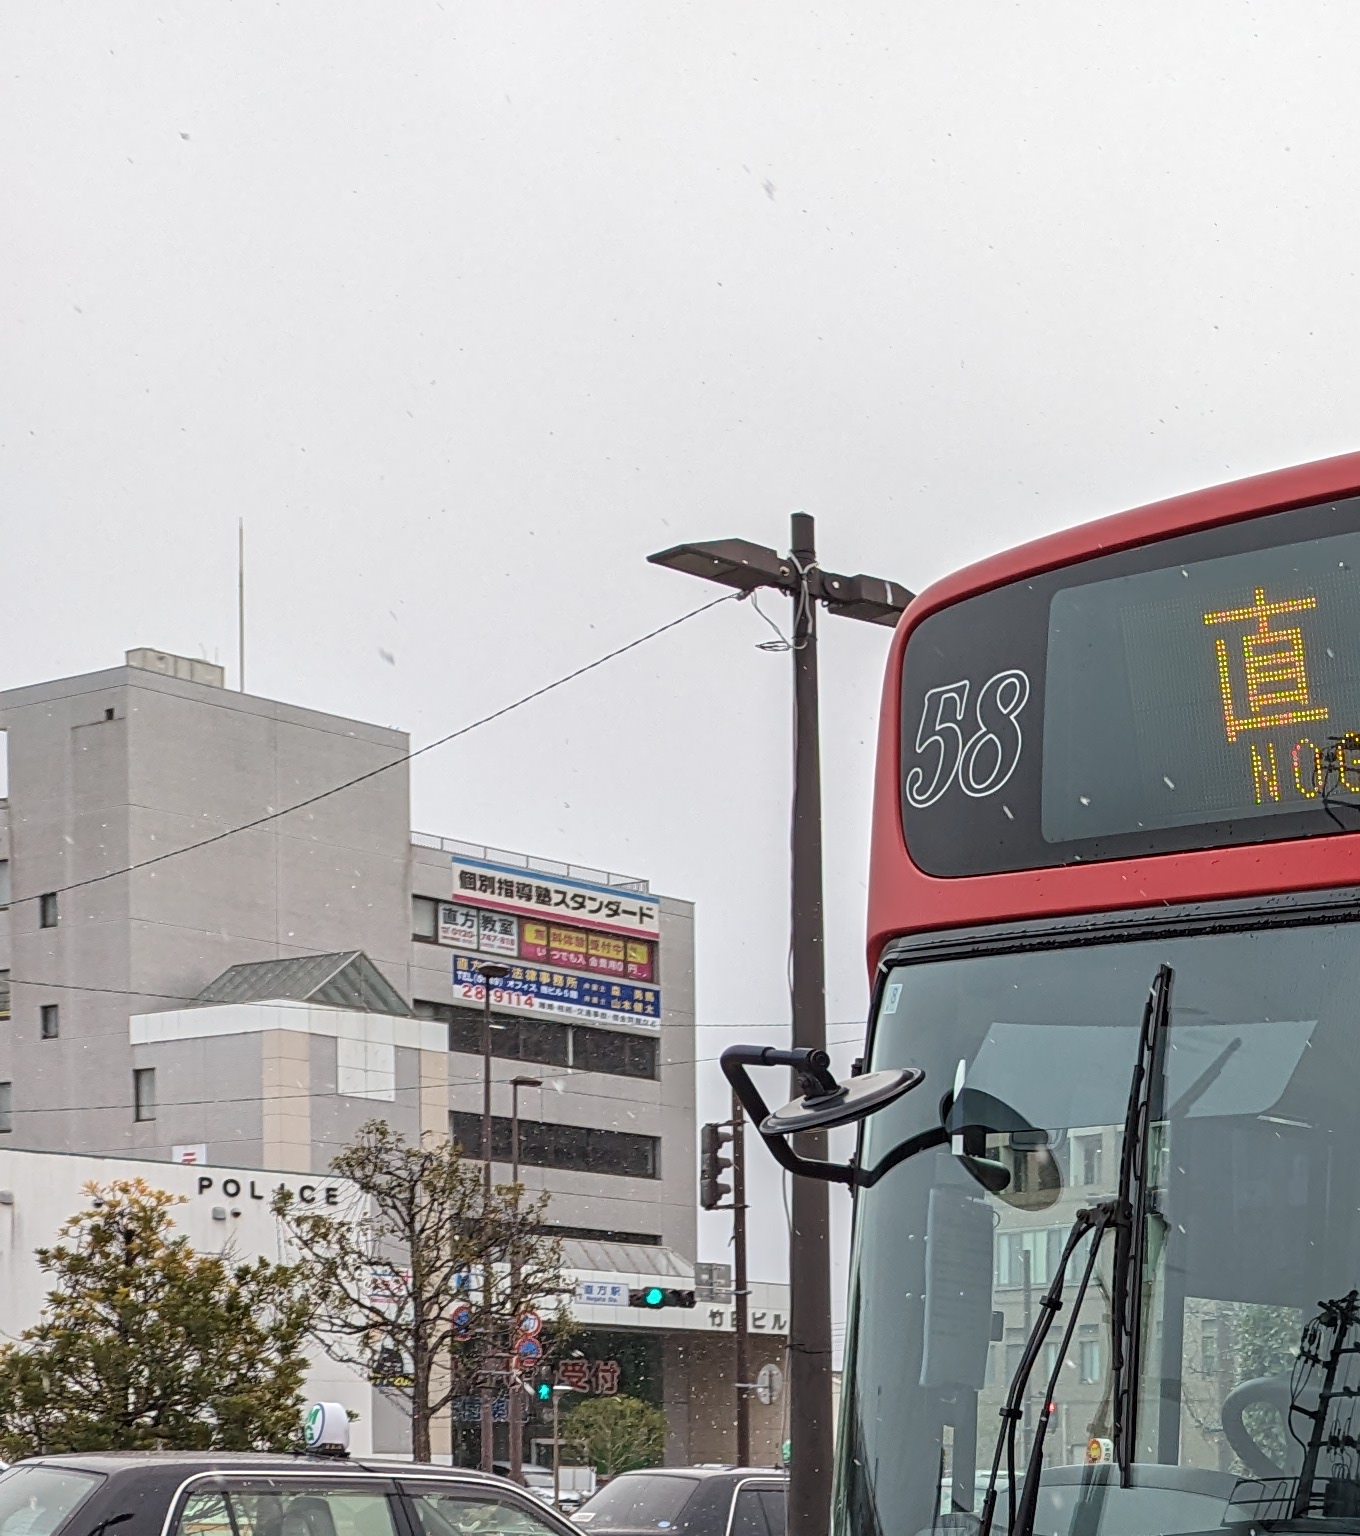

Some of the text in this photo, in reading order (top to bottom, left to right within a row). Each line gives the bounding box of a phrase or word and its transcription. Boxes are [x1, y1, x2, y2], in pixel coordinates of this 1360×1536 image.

[905, 669, 1030, 809] 58
[459, 869, 654, 924] 個別指導塾スタンダード
[456, 955, 578, 989] 直方法律事務所
[584, 1284, 620, 1297] 直方駅
